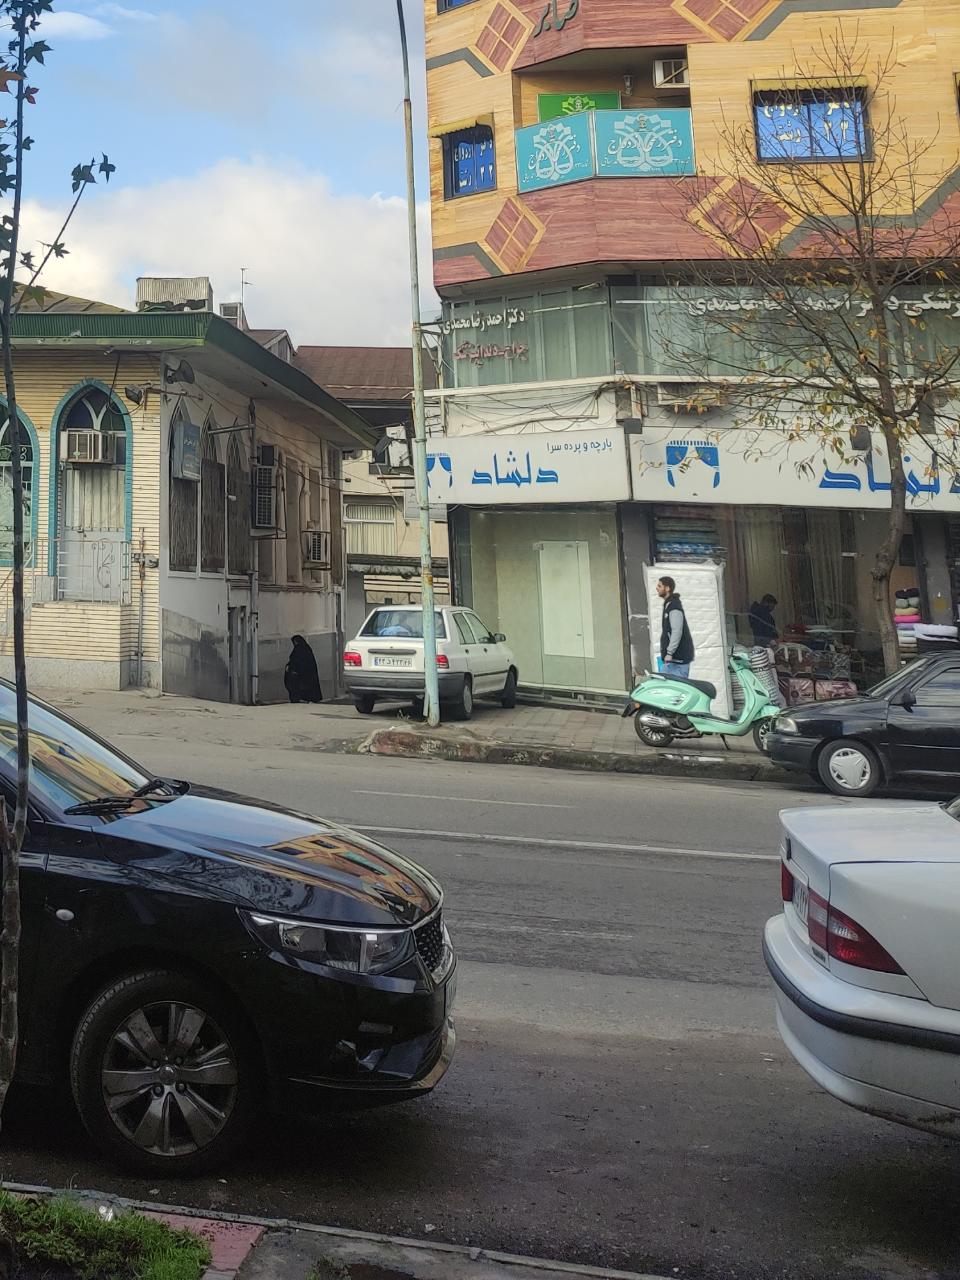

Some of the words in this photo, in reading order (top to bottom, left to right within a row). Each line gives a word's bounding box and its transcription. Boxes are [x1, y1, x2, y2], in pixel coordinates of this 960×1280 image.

[471, 310, 485, 332] رضا
[486, 308, 507, 326] احمد
[507, 307, 525, 329] دکتر
[442, 319, 471, 335] محمدی
[546, 441, 562, 454] سرا
[583, 441, 588, 452] و
[590, 437, 612, 454] پارچه
[471, 450, 559, 488] دلشاد
[819, 449, 960, 497] لاد
